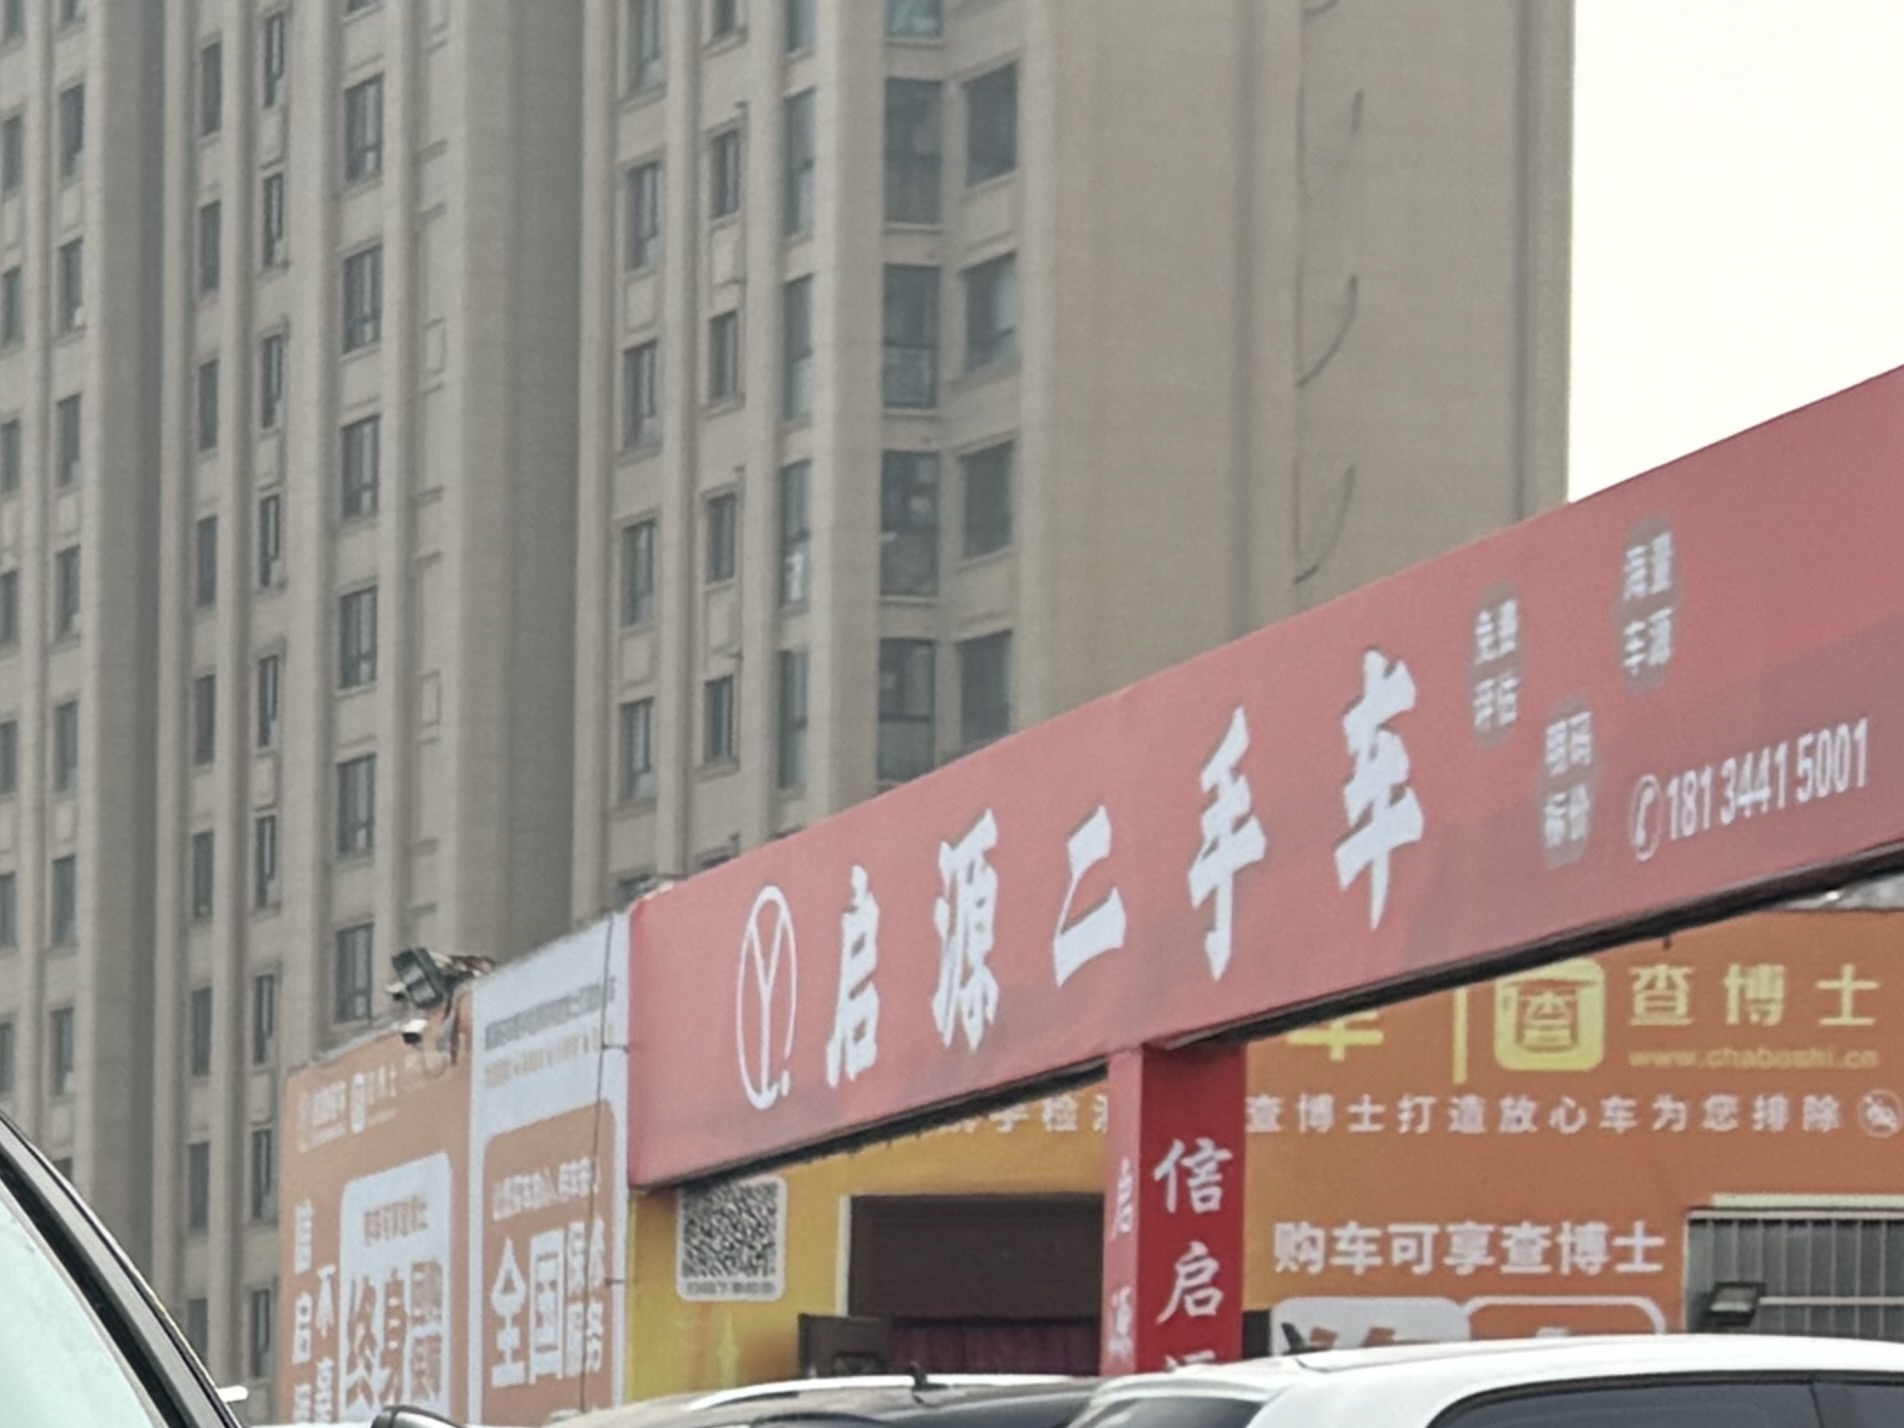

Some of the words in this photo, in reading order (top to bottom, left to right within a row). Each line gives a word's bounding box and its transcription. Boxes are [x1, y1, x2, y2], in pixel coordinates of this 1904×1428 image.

[826, 646, 1424, 1088] 启源二手车
[1629, 963, 1880, 1026] 查博士
[1246, 1094, 1841, 1134] 查博士打造放心车为您排除
[1153, 1137, 1234, 1371] 信启
[1273, 1220, 1666, 1275] 购车可享查博士
[490, 1227, 566, 1388] 全国
